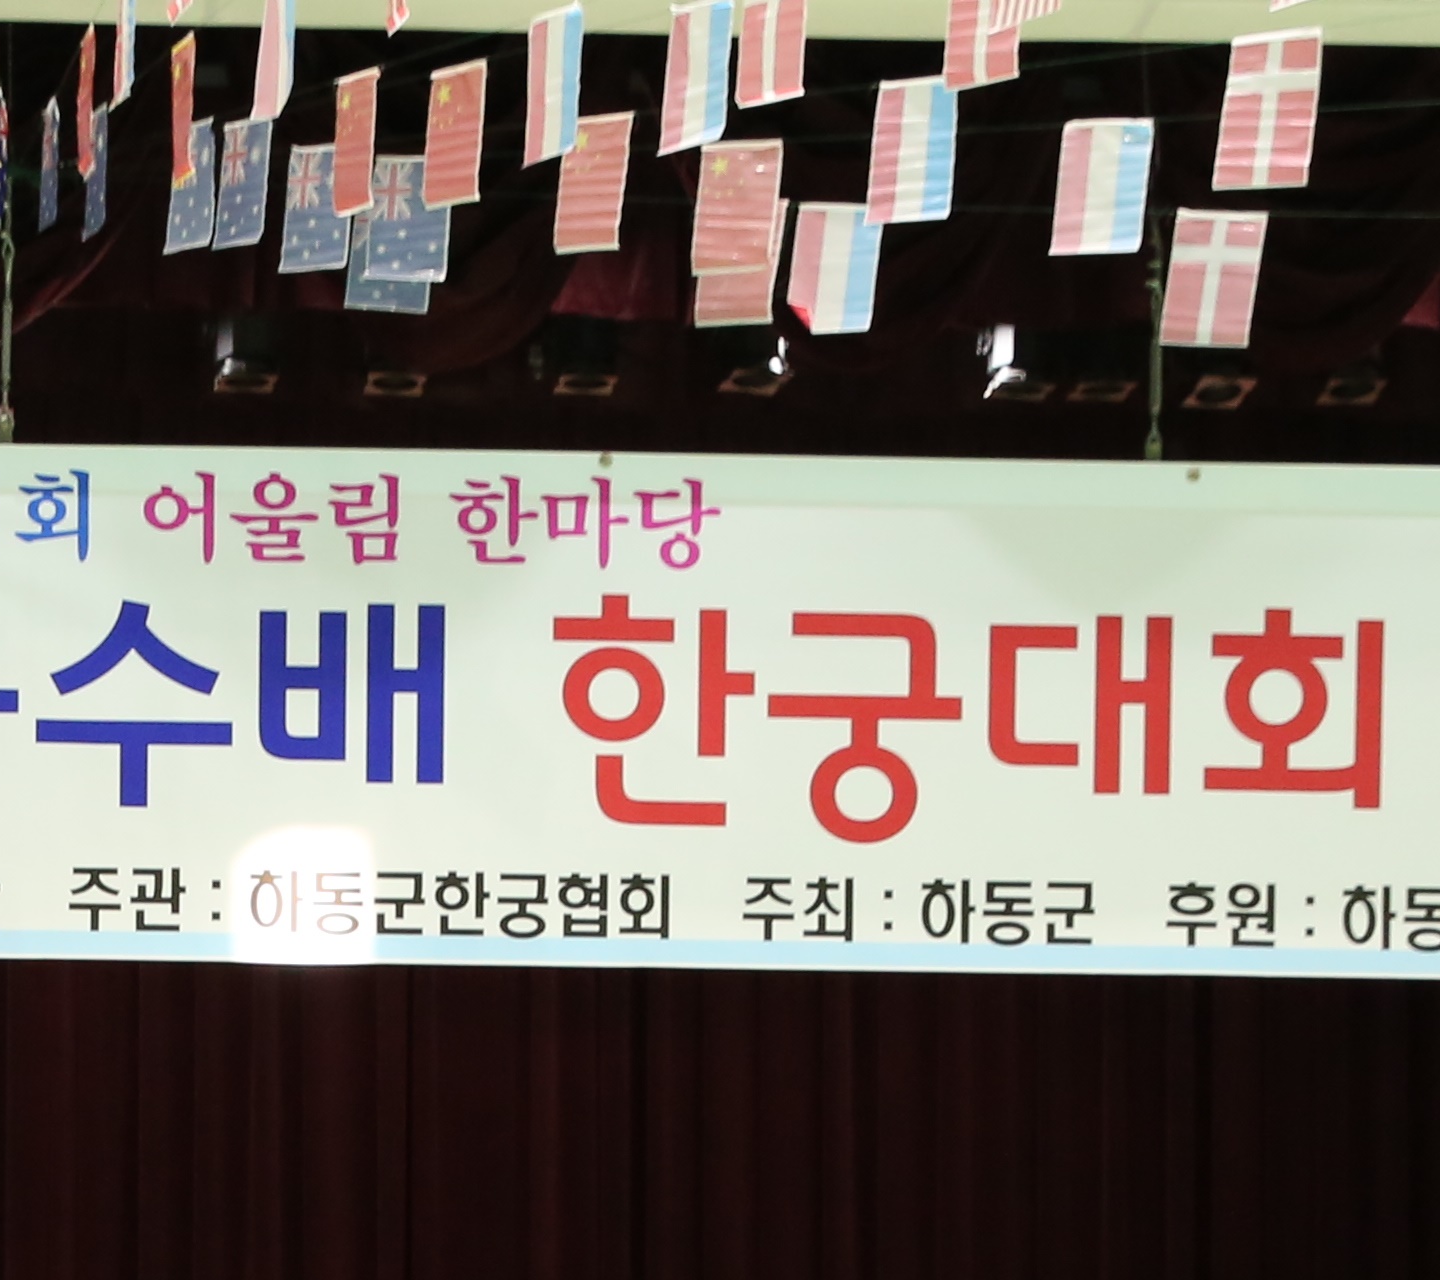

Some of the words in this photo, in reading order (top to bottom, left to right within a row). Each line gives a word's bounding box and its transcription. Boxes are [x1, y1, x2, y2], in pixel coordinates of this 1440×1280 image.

[144, 472, 399, 565] 어울림
[451, 475, 721, 570] 한마당
[553, 594, 1384, 843] 한궁대회
[69, 867, 186, 932] 주관
[250, 868, 672, 940] 하동군한궁협회
[742, 876, 854, 942] 주최
[922, 878, 1095, 946] 하동군
[1166, 882, 1276, 948] 후원
